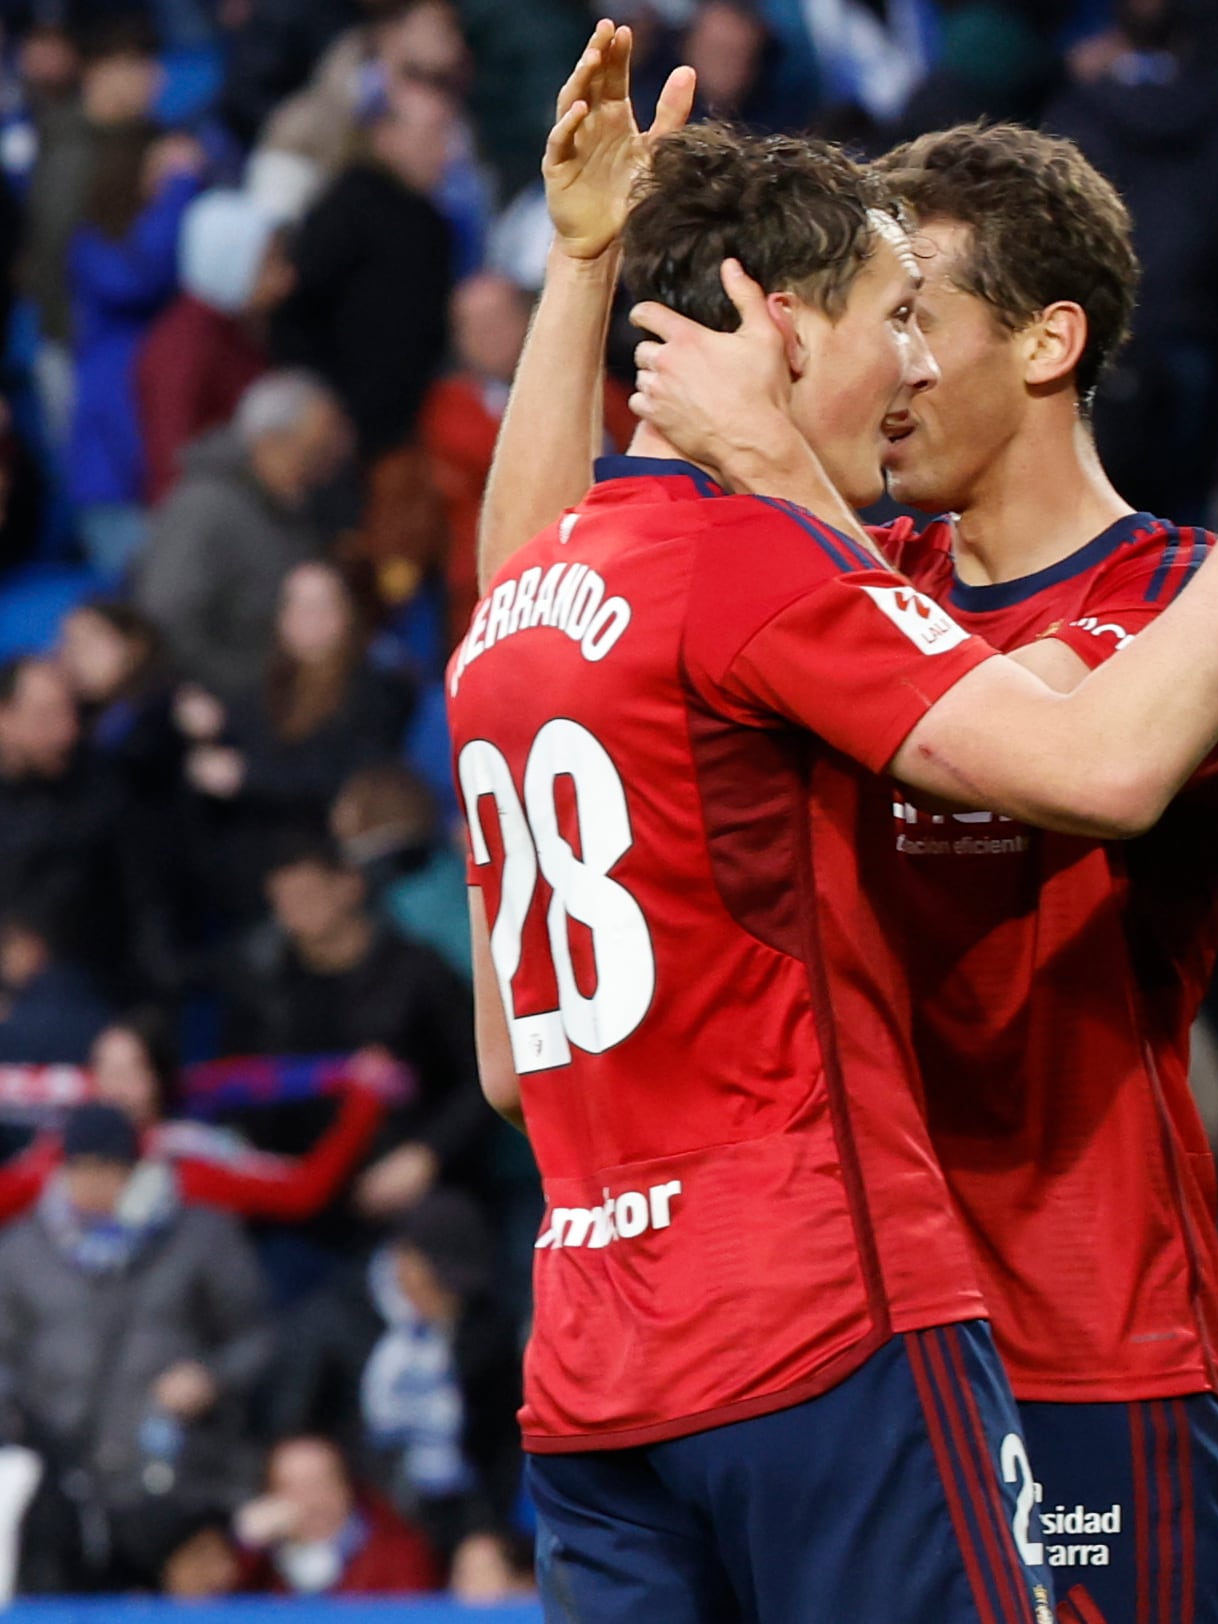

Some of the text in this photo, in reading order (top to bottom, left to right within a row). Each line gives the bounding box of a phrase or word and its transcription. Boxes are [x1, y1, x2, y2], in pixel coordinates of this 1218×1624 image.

[457, 716, 656, 1075] 28
[1041, 1504, 1121, 1535] sidad
[1047, 1543, 1110, 1567] arra
